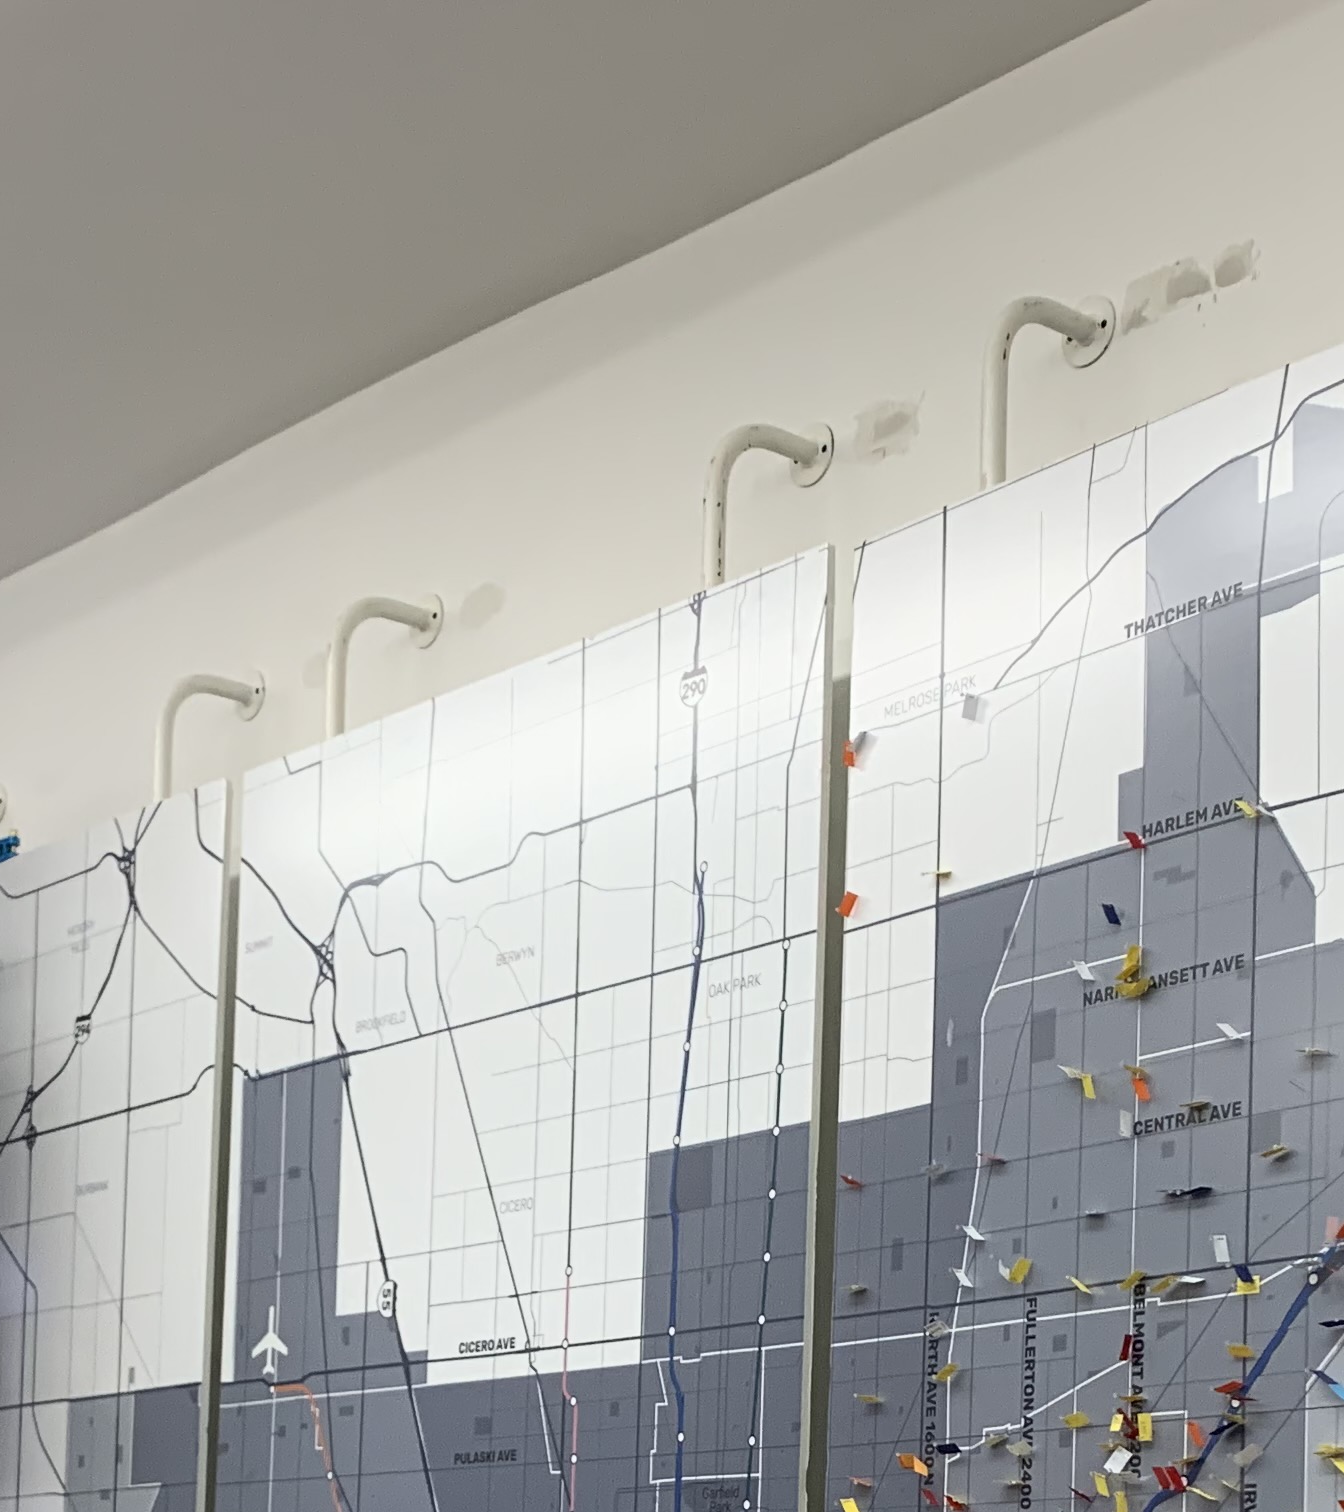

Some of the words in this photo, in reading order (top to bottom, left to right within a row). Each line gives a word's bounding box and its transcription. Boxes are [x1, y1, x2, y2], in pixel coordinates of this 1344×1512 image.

[1123, 596, 1208, 640] THATCHER
[1211, 581, 1245, 609] AVE
[682, 678, 706, 700] 290
[883, 686, 941, 721] MELROSE
[944, 673, 977, 696] PARK
[1141, 806, 1210, 840] HARLEM
[1211, 796, 1245, 822] AVE
[495, 946, 536, 967] BERWYN
[1212, 953, 1246, 976] AVE
[708, 980, 731, 999] OAK
[732, 973, 763, 993] PARK
[1132, 1106, 1207, 1137] CENTRAL
[1209, 1100, 1243, 1122] AVE
[499, 1197, 534, 1214] CICERO
[458, 1339, 495, 1355] CICERO
[496, 1336, 517, 1350] AVE
[1131, 1282, 1147, 1380] BELMONT
[1022, 1297, 1038, 1417] FULLERTON
[924, 1380, 938, 1418] AVE
[453, 1449, 496, 1466] PULASKI
[496, 1448, 518, 1463] AVE
[923, 1420, 937, 1471] 1600
[923, 1476, 935, 1486] N
[1019, 1458, 1034, 1511] 2400
